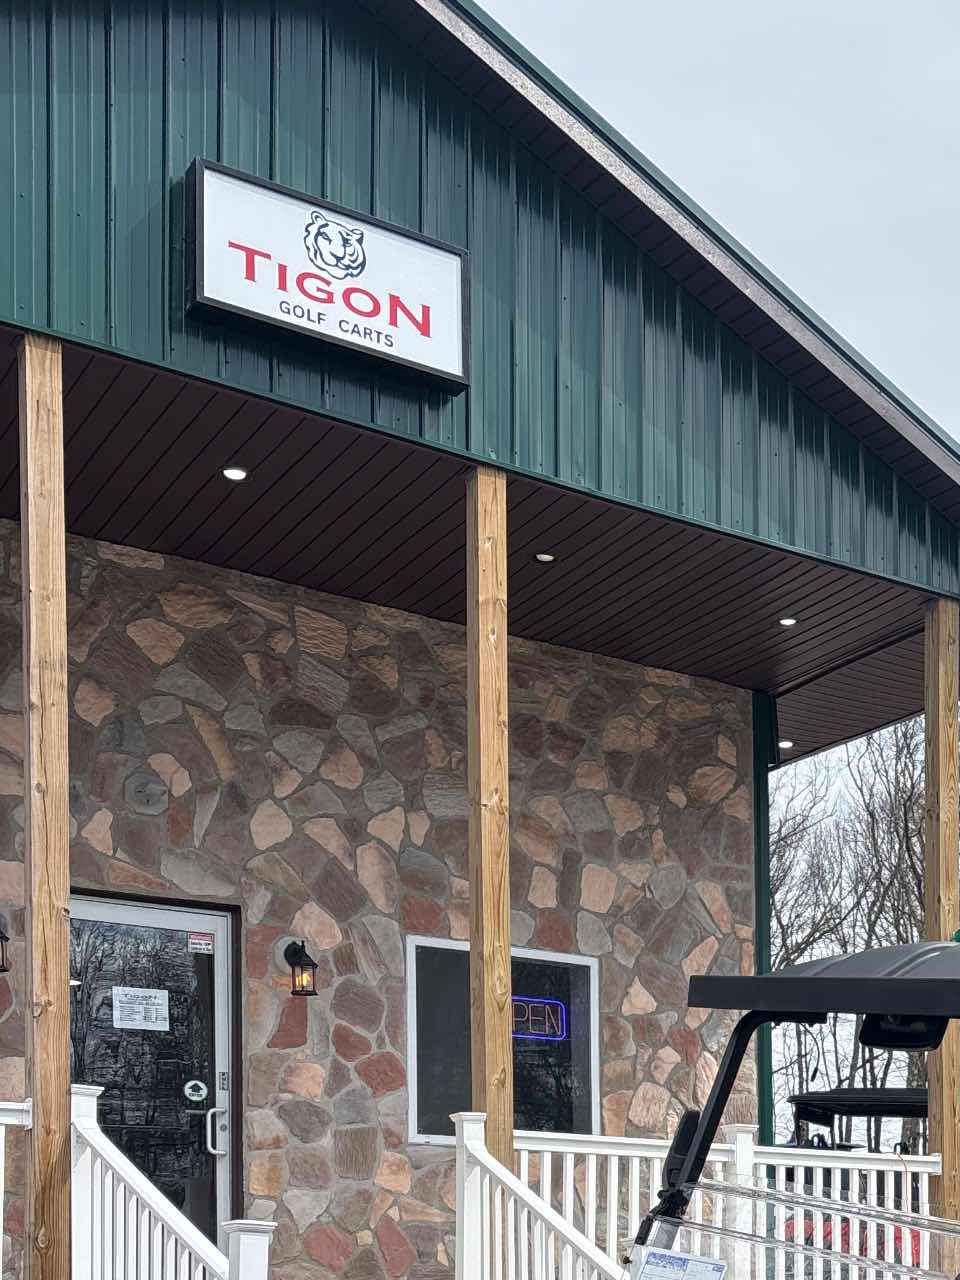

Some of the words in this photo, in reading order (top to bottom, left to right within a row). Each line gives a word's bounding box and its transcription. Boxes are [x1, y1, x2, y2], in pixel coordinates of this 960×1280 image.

[228, 240, 431, 338] TIGON
[279, 300, 327, 325] GOLF
[338, 319, 394, 348] CARTS
[512, 1001, 561, 1036] PEN
